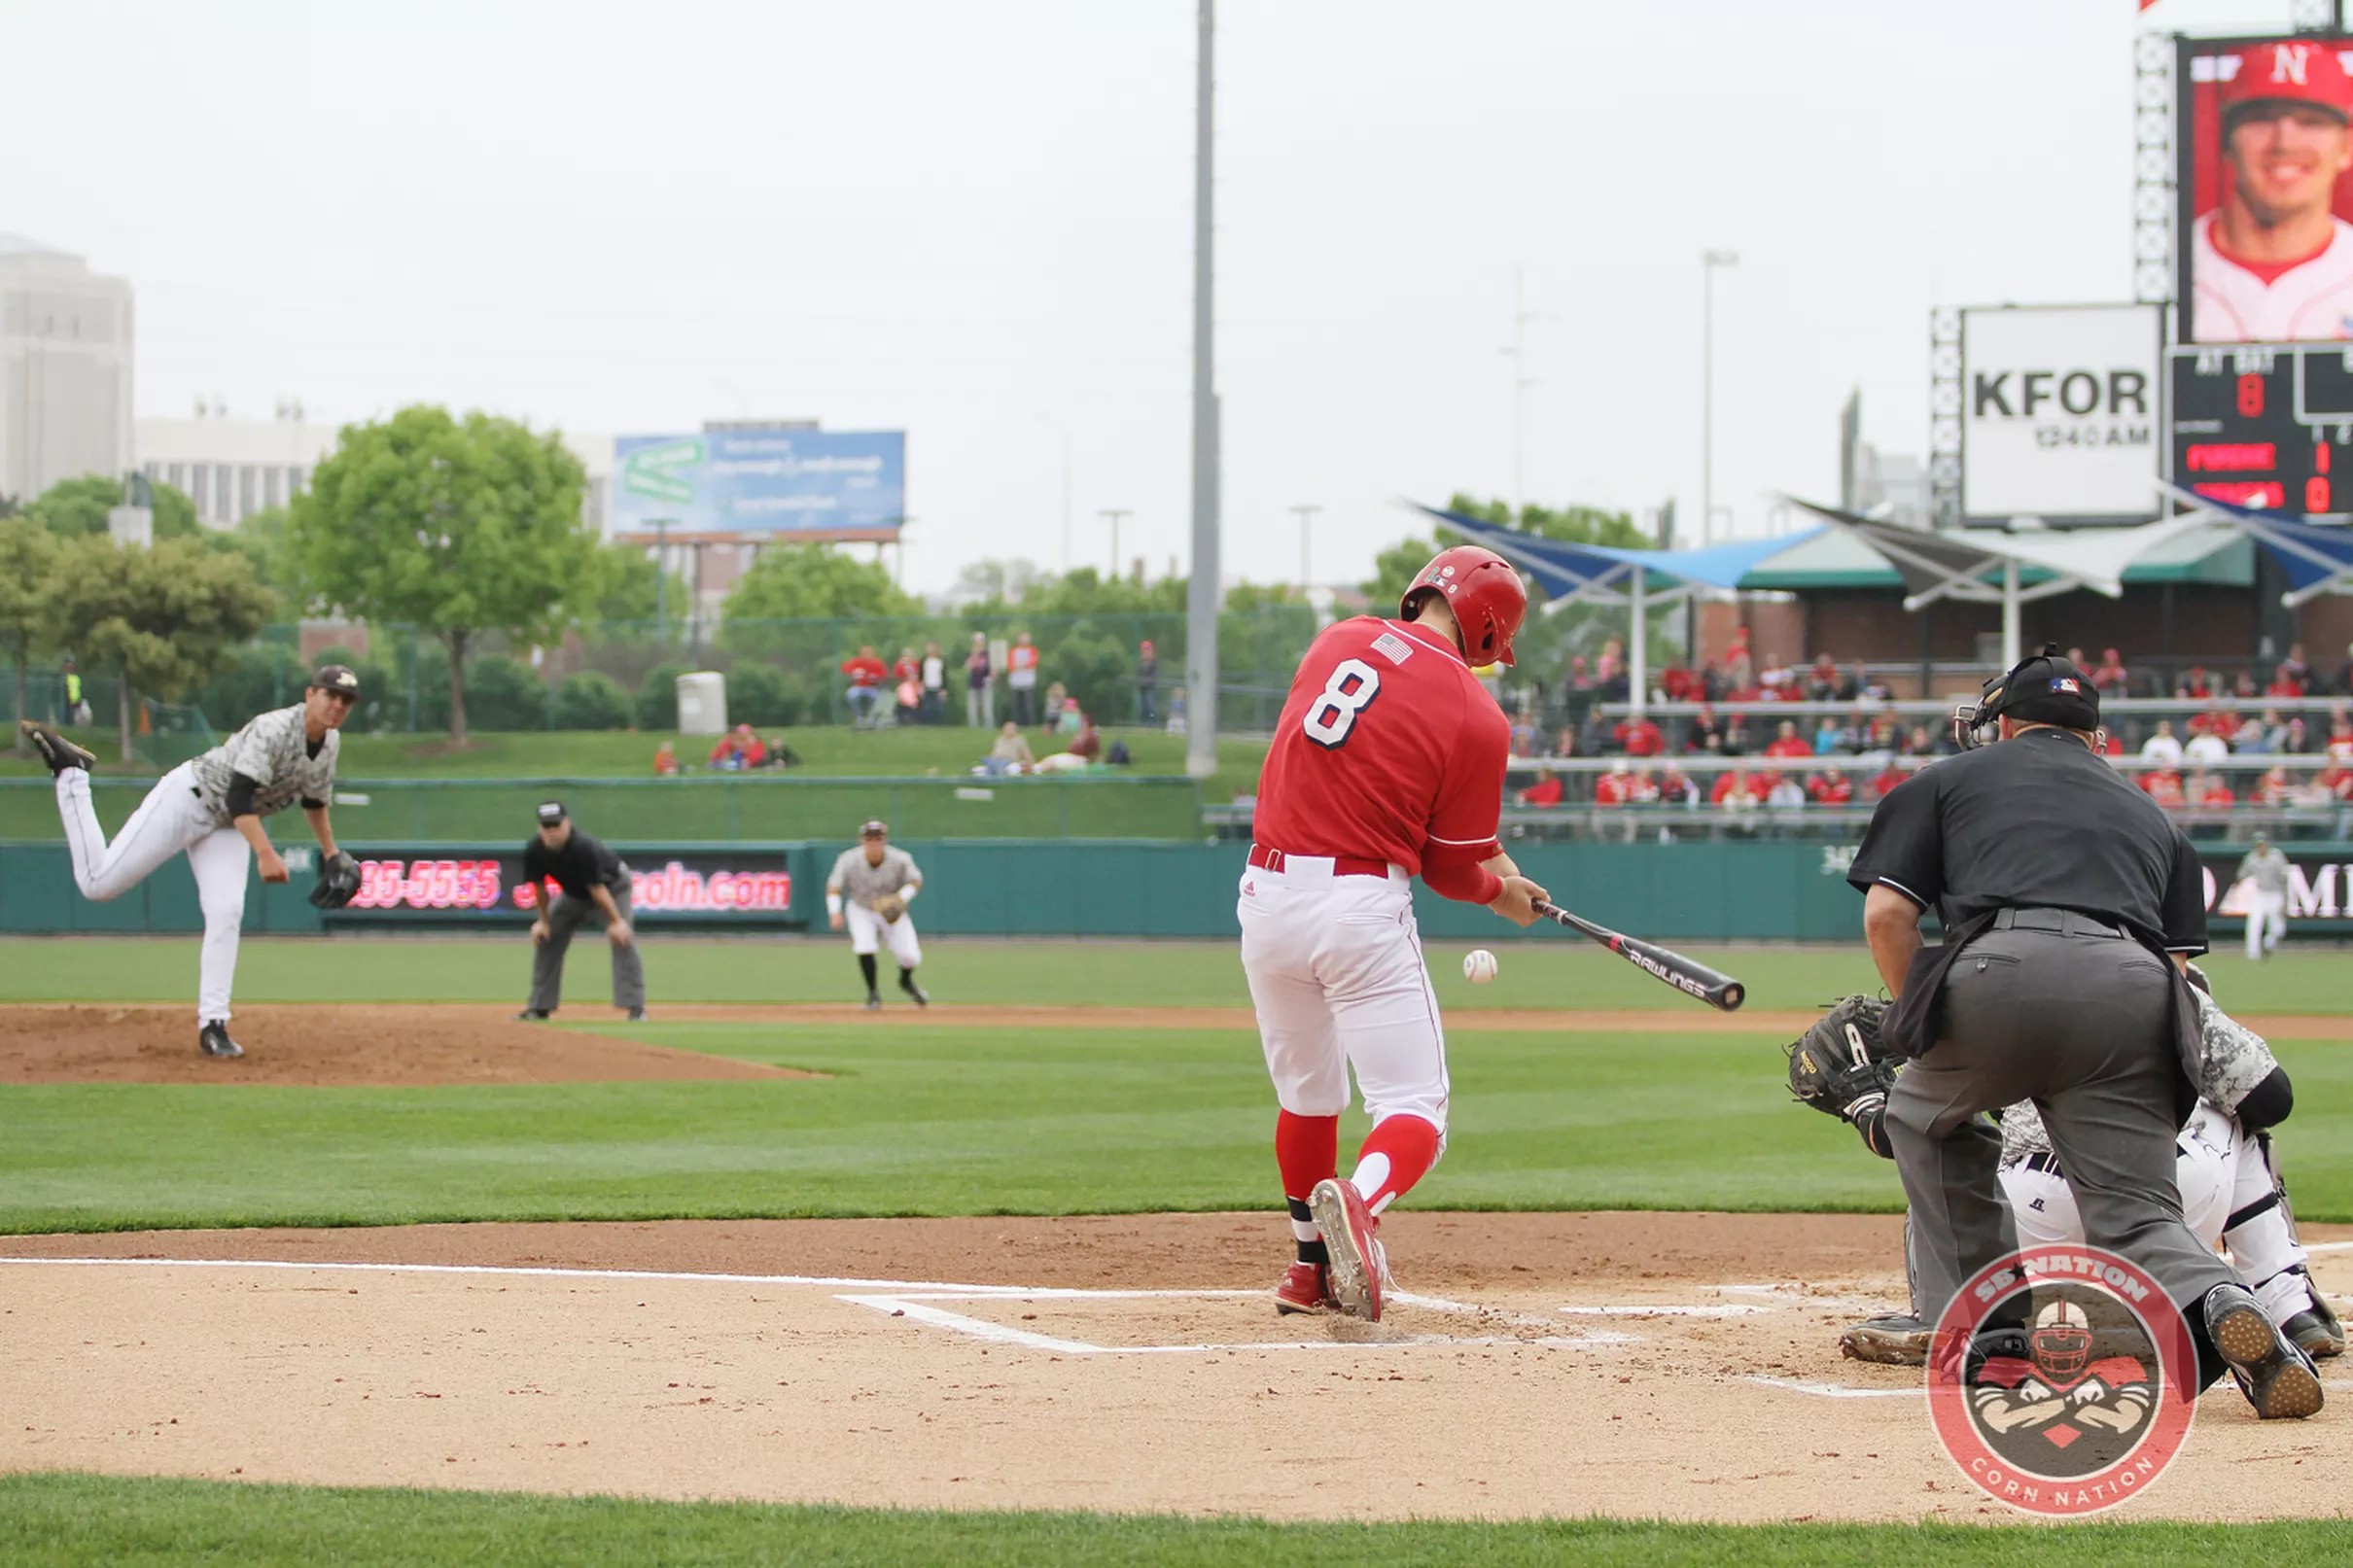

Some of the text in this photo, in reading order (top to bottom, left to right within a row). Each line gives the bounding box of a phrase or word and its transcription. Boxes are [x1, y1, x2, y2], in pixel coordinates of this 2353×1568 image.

[2271, 45, 2308, 86] N
[1975, 371, 2147, 416] KFOR
[1303, 658, 1382, 750] 8
[1629, 949, 1706, 998] RAWLINGS
